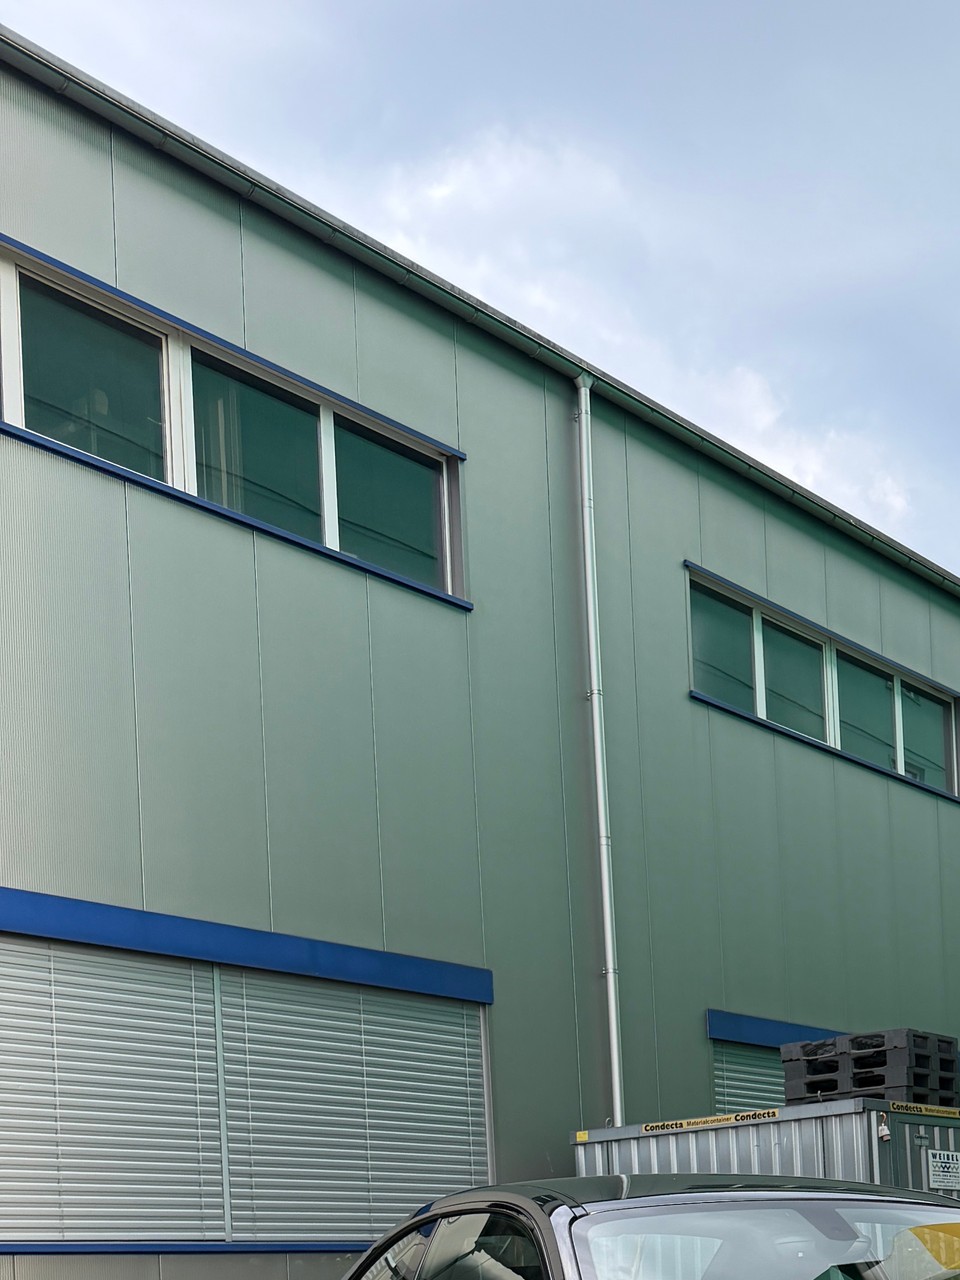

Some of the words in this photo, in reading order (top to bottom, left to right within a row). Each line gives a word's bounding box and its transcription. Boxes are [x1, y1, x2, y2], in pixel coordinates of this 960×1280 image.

[891, 1102, 923, 1113] Condecta
[644, 1121, 684, 1132] Condecta
[686, 1116, 732, 1126] Materialcontainer
[734, 1110, 777, 1122] Condecta
[931, 1152, 959, 1162] WEIBEL
